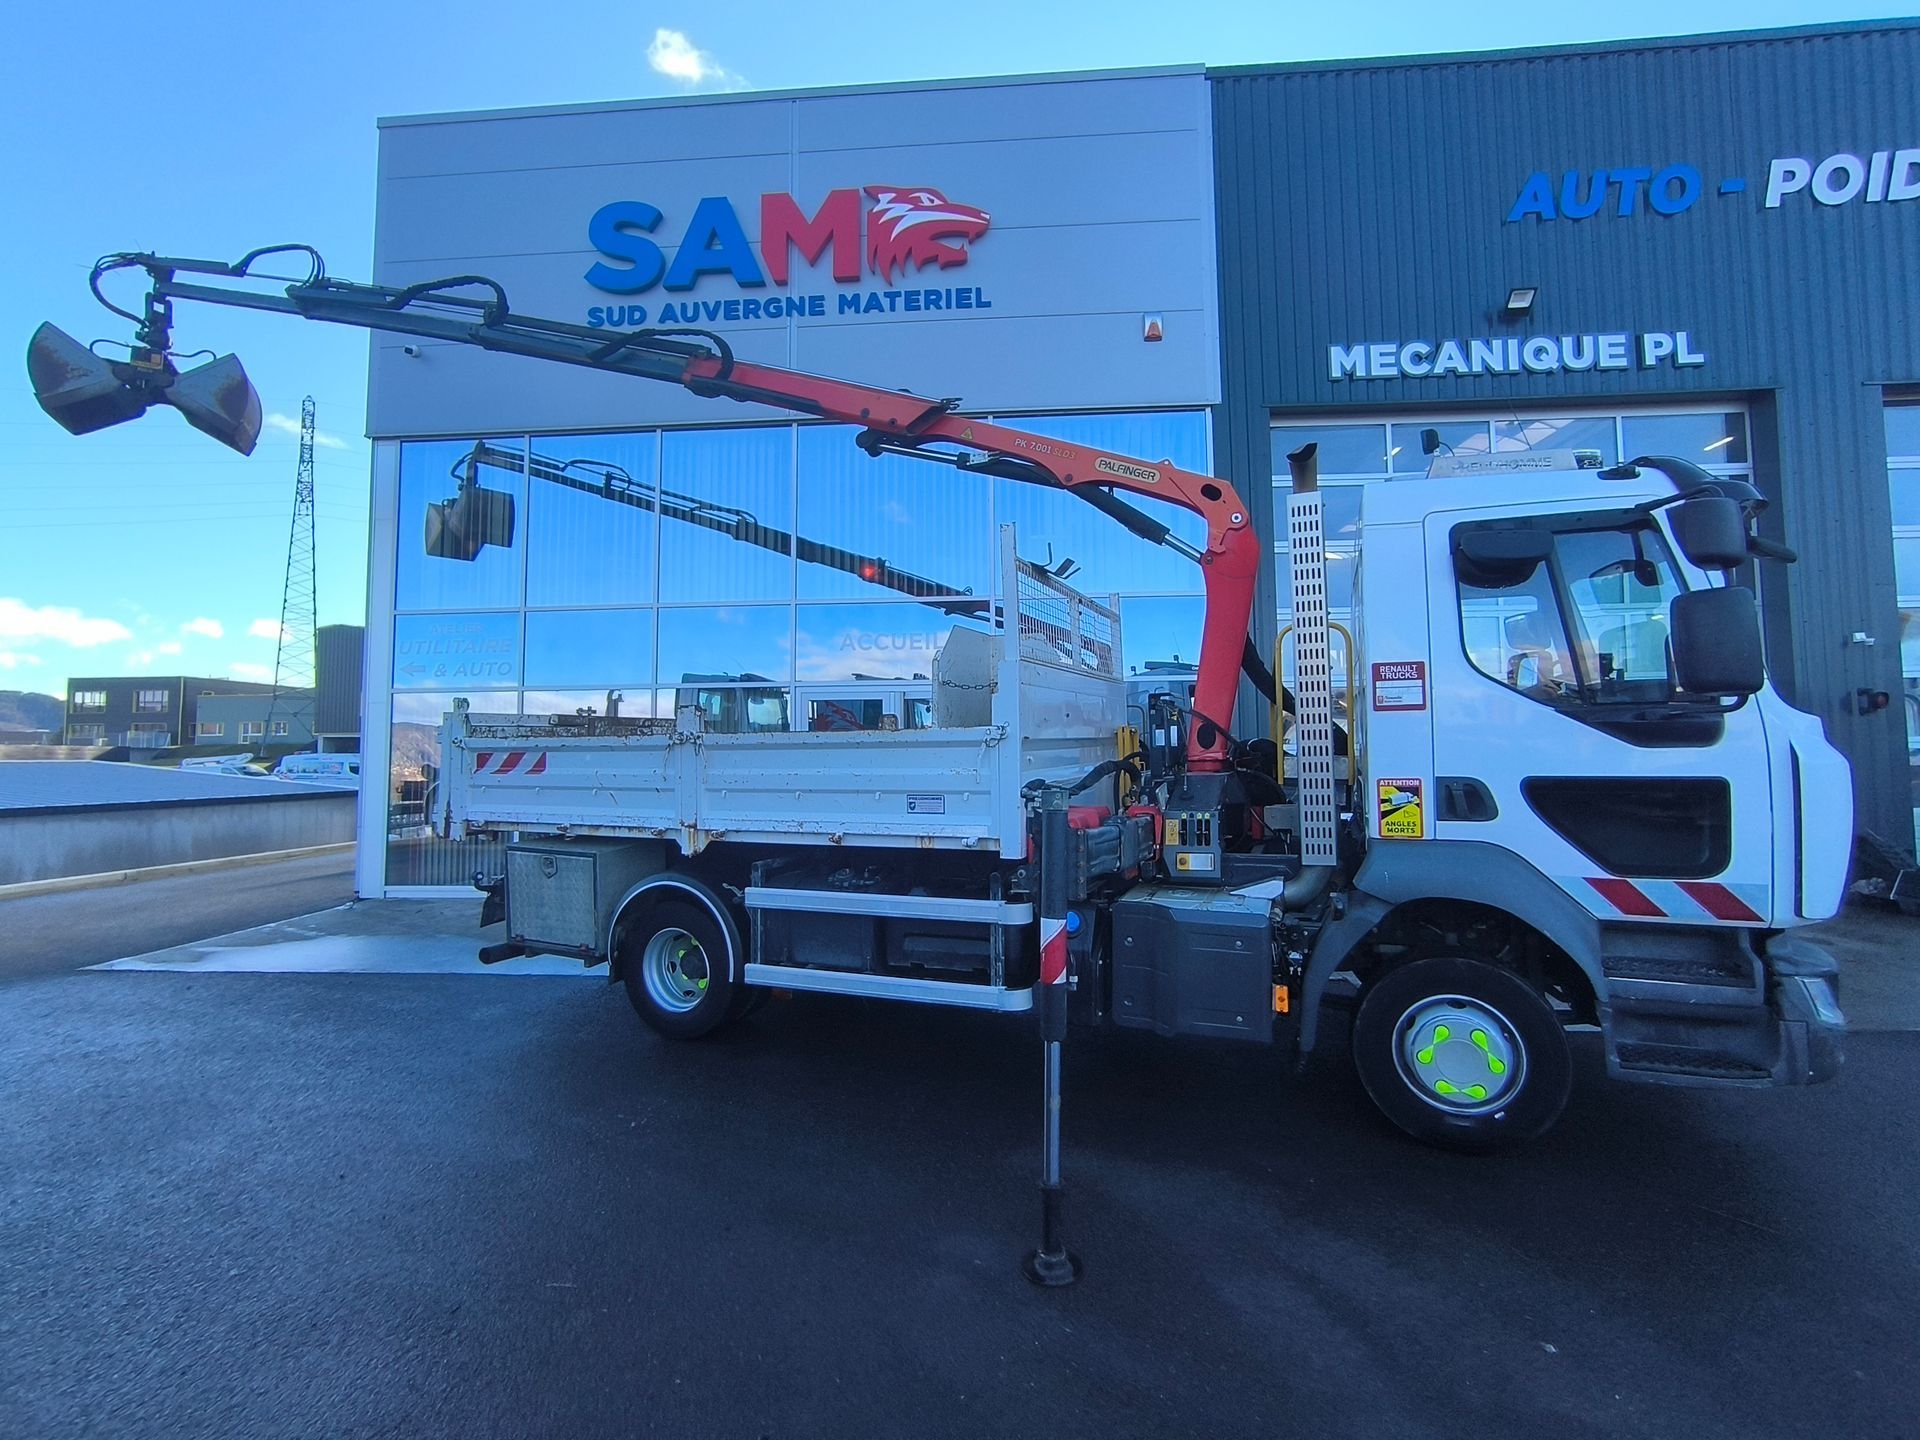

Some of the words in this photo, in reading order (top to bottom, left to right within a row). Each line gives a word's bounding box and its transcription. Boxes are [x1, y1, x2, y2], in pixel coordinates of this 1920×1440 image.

[1507, 163, 1703, 222] AUTO
[584, 187, 862, 295] SAM
[587, 305, 647, 328] SUD
[658, 294, 826, 324] AUVERGNE
[838, 286, 992, 315] MATERIEL
[1328, 333, 1631, 381] MECANIQUE
[1641, 331, 1706, 368] PL
[1014, 438, 1027, 448] PK
[1098, 459, 1157, 481] PALFINGER
[398, 637, 513, 655] UTILITAIRE
[839, 632, 944, 651] ACCUEIL
[433, 663, 448, 677] &
[453, 661, 513, 677] AUTO
[1379, 665, 1418, 673] RENAULT
[1380, 671, 1418, 679] TRUCKS
